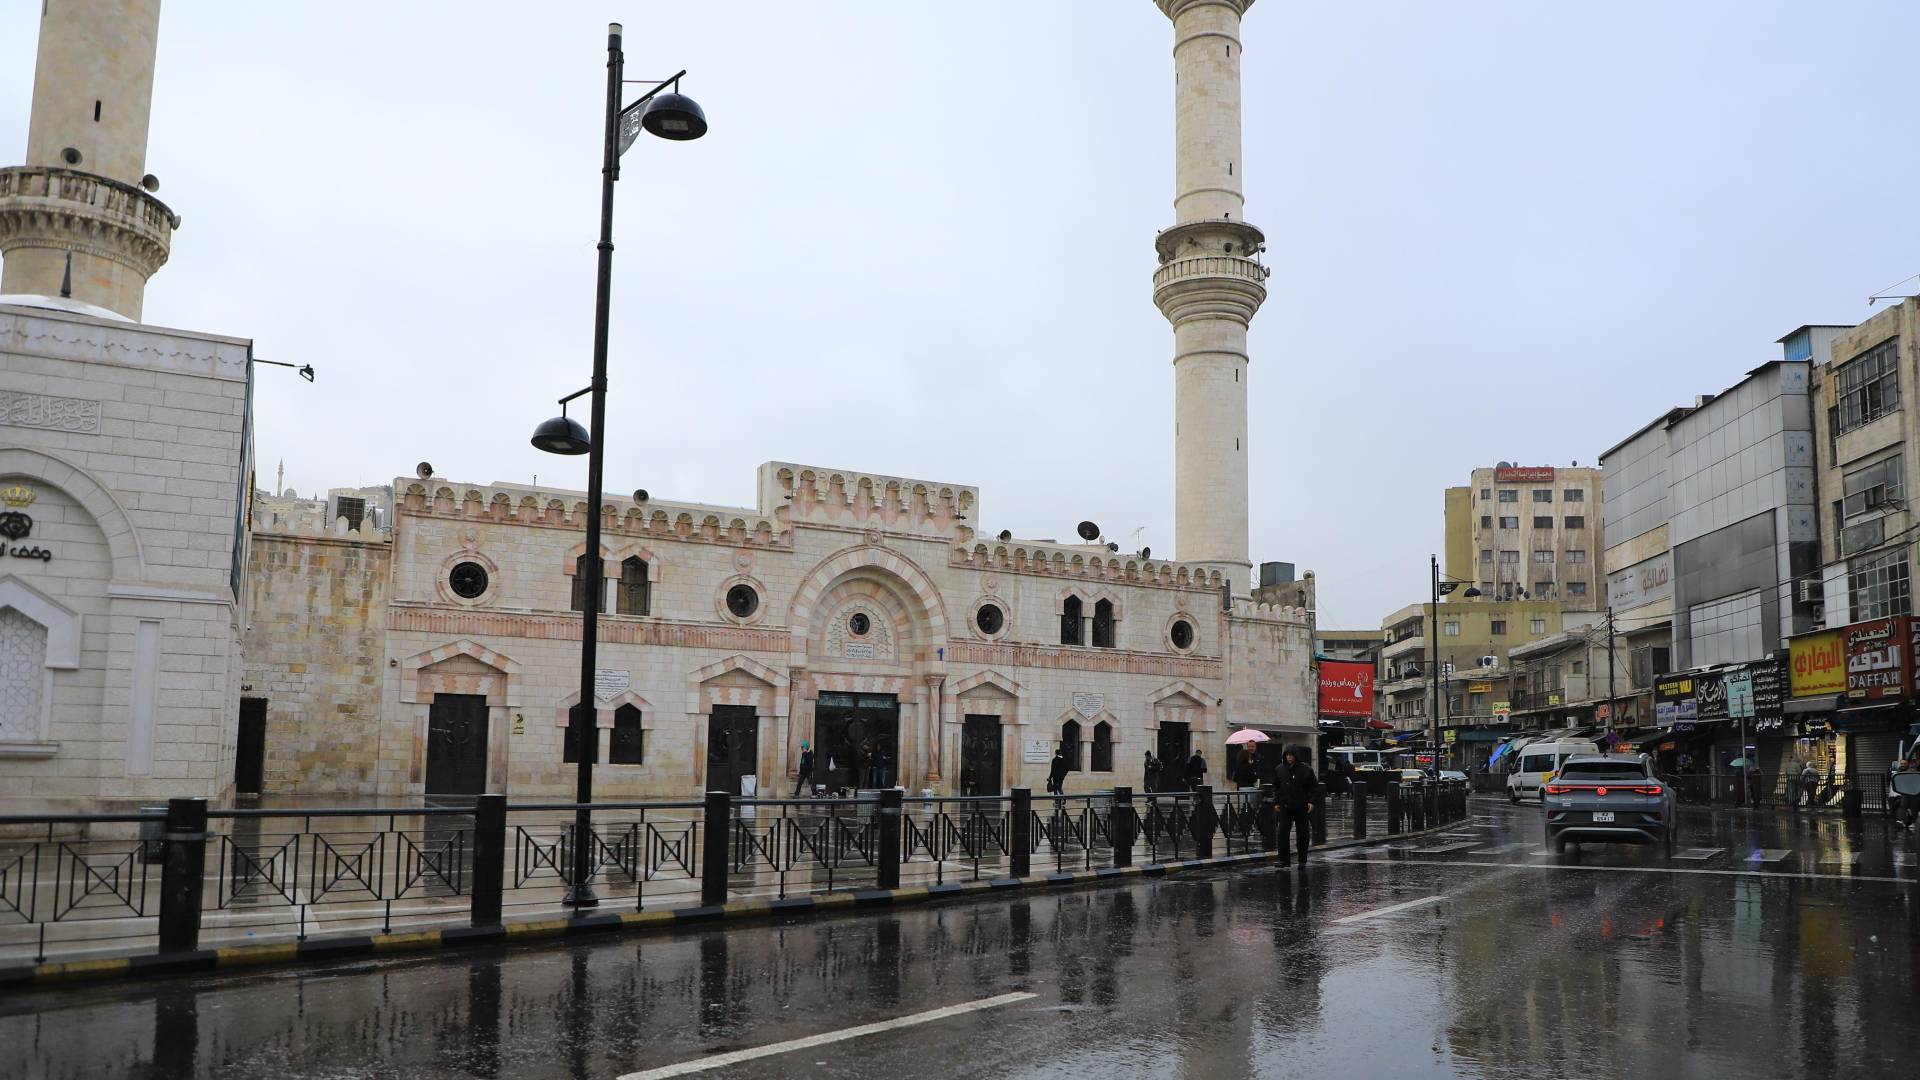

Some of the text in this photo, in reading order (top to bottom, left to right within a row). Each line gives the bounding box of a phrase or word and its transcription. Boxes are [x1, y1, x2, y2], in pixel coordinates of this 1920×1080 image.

[10, 545, 52, 563] وقف
[1642, 562, 1669, 597] نضالكو
[1795, 641, 1842, 678] البخاري
[1659, 681, 1679, 691] WESTERN
[1848, 671, 1900, 688] DAFFAH
[1664, 688, 1679, 696] UNION
